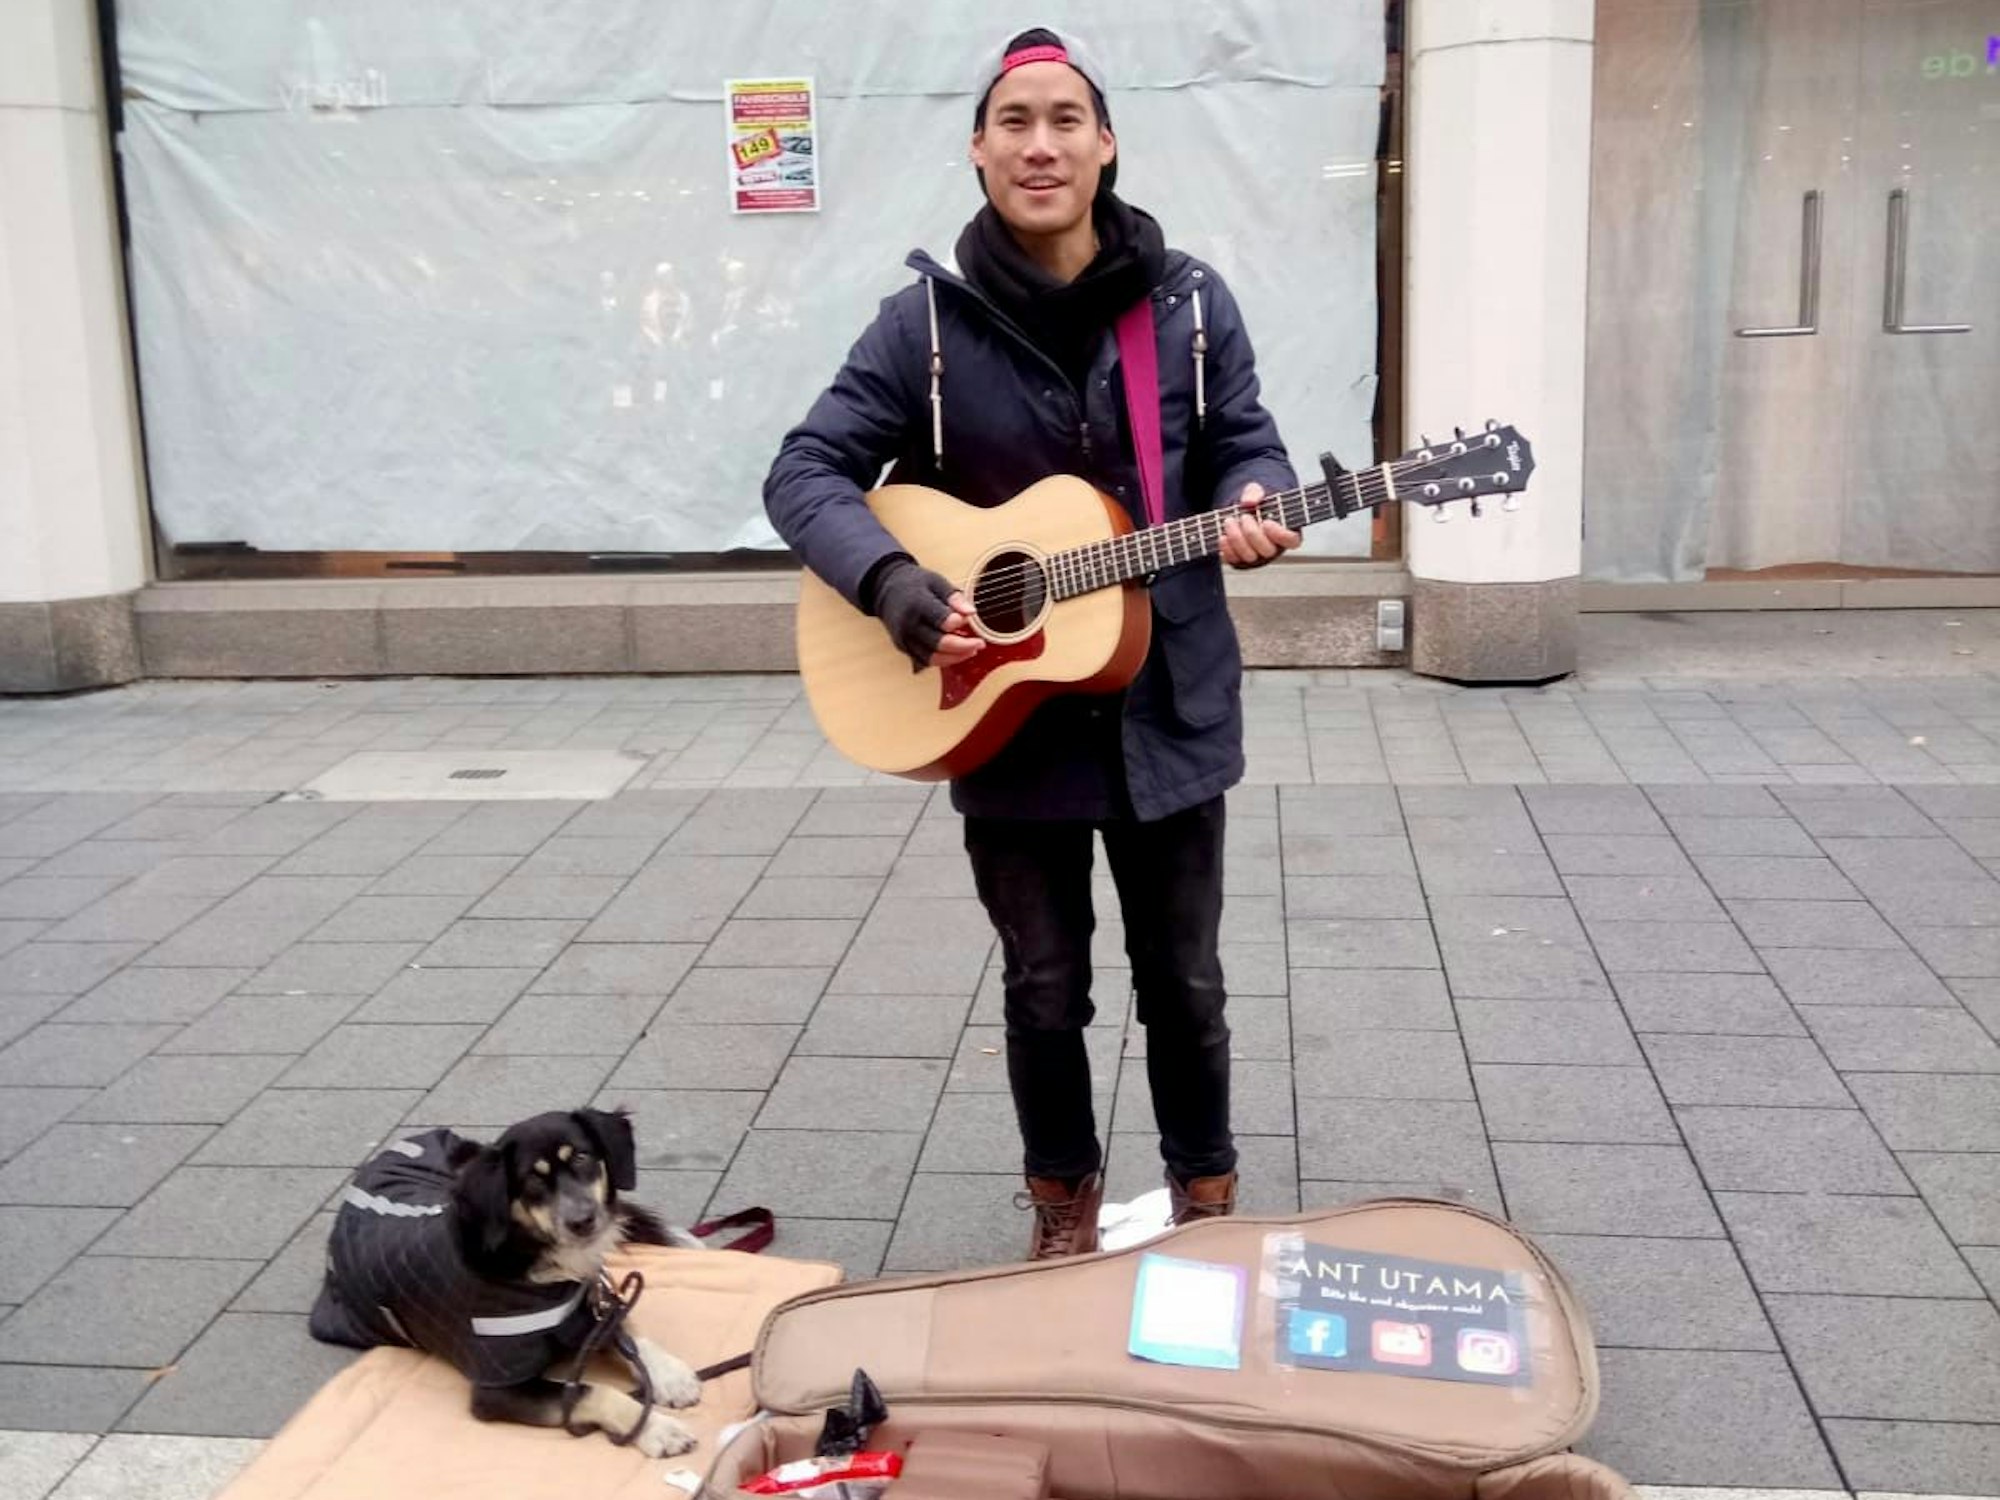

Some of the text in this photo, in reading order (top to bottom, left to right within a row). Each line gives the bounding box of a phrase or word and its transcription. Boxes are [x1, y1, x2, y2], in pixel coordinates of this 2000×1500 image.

[740, 137, 769, 157] 149
[1289, 1257, 1511, 1304] ANT UTAMA
